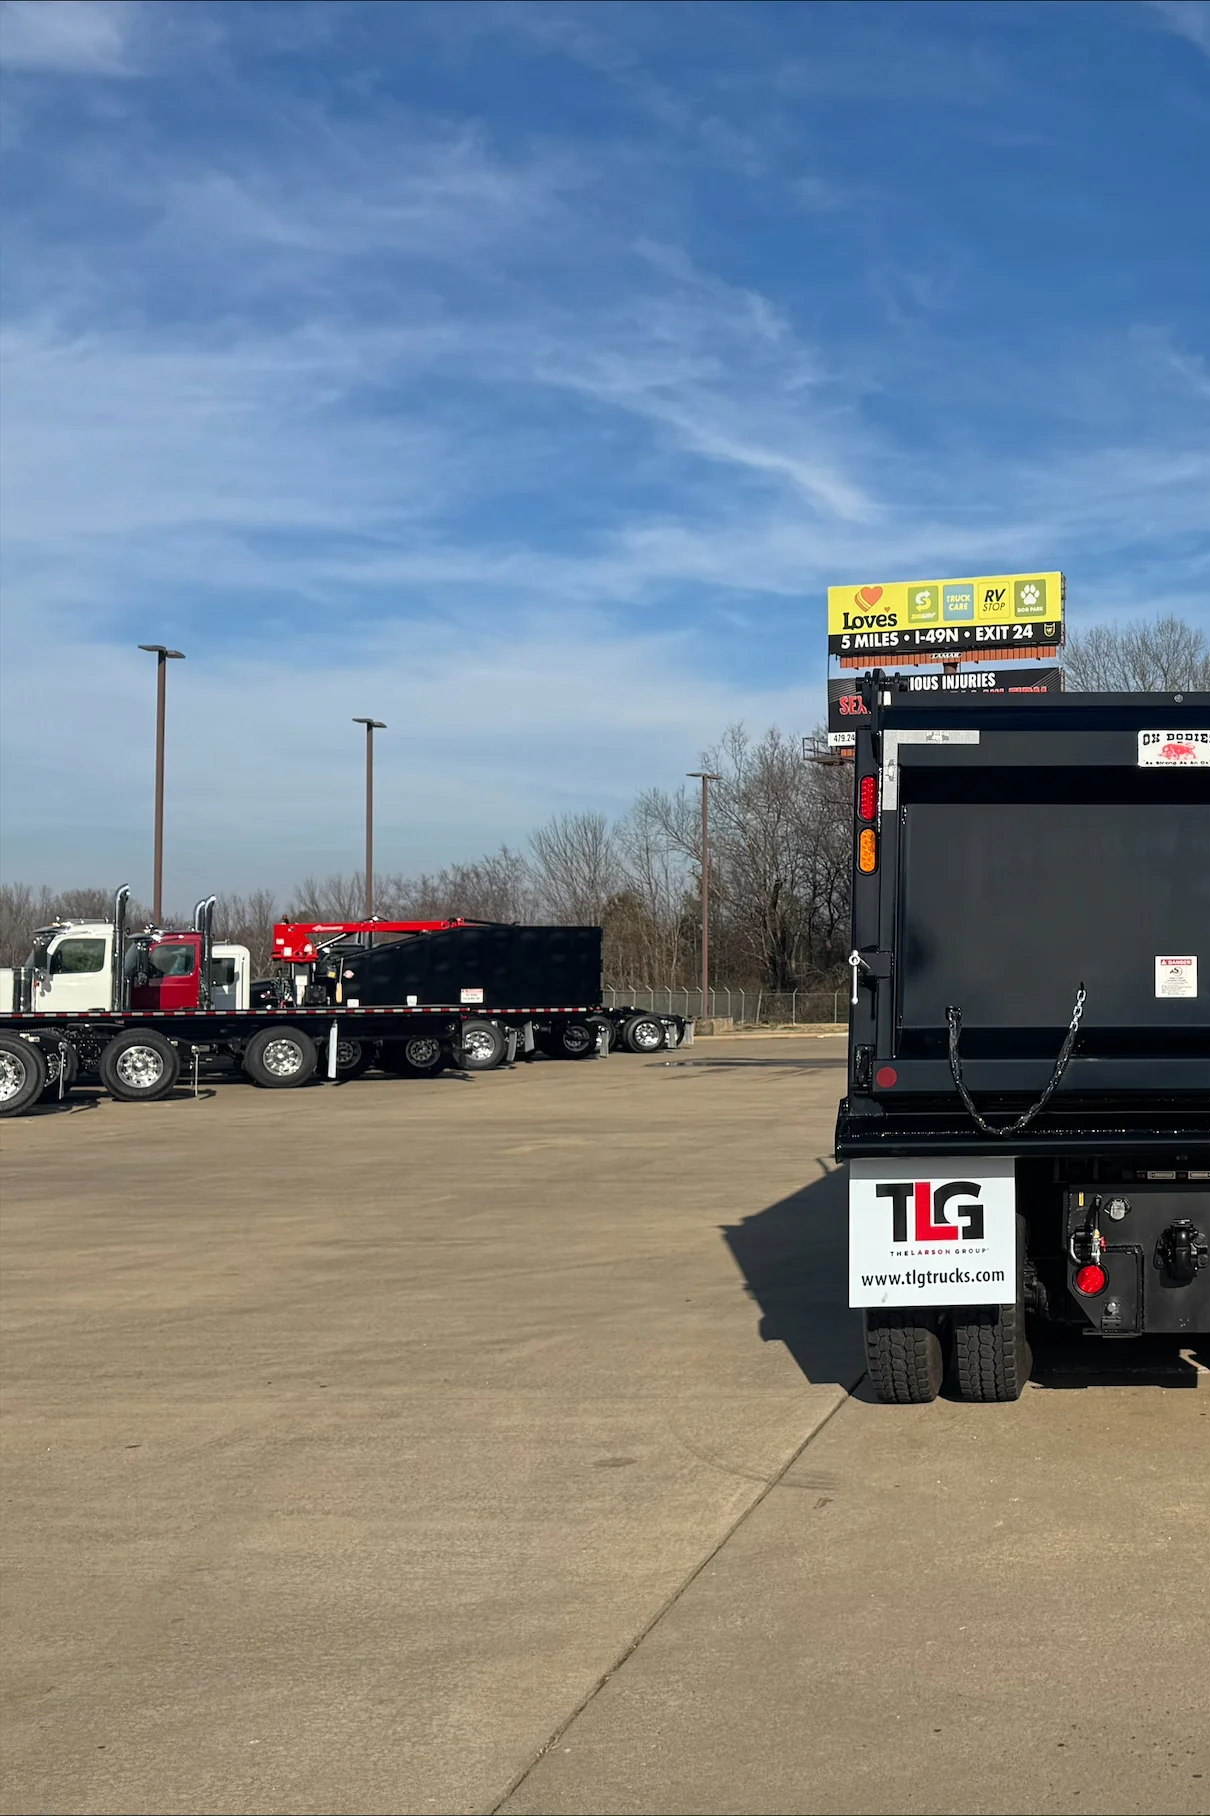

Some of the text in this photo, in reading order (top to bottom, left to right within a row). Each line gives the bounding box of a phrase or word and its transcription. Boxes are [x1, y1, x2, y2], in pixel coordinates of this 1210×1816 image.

[946, 594, 970, 603] TRUCK
[984, 588, 1006, 602] RV
[948, 602, 968, 611] CARE
[982, 602, 1005, 611] STOP
[841, 624, 1033, 649] 5 MILES I-49N EXIT 24
[908, 676, 939, 691] IOUS
[942, 672, 996, 690] INJURIES
[834, 733, 855, 742] 479.24
[1143, 734, 1160, 746] OX
[876, 1181, 984, 1242] TLG
[861, 1268, 1005, 1288] www.tlgtrucks.com
